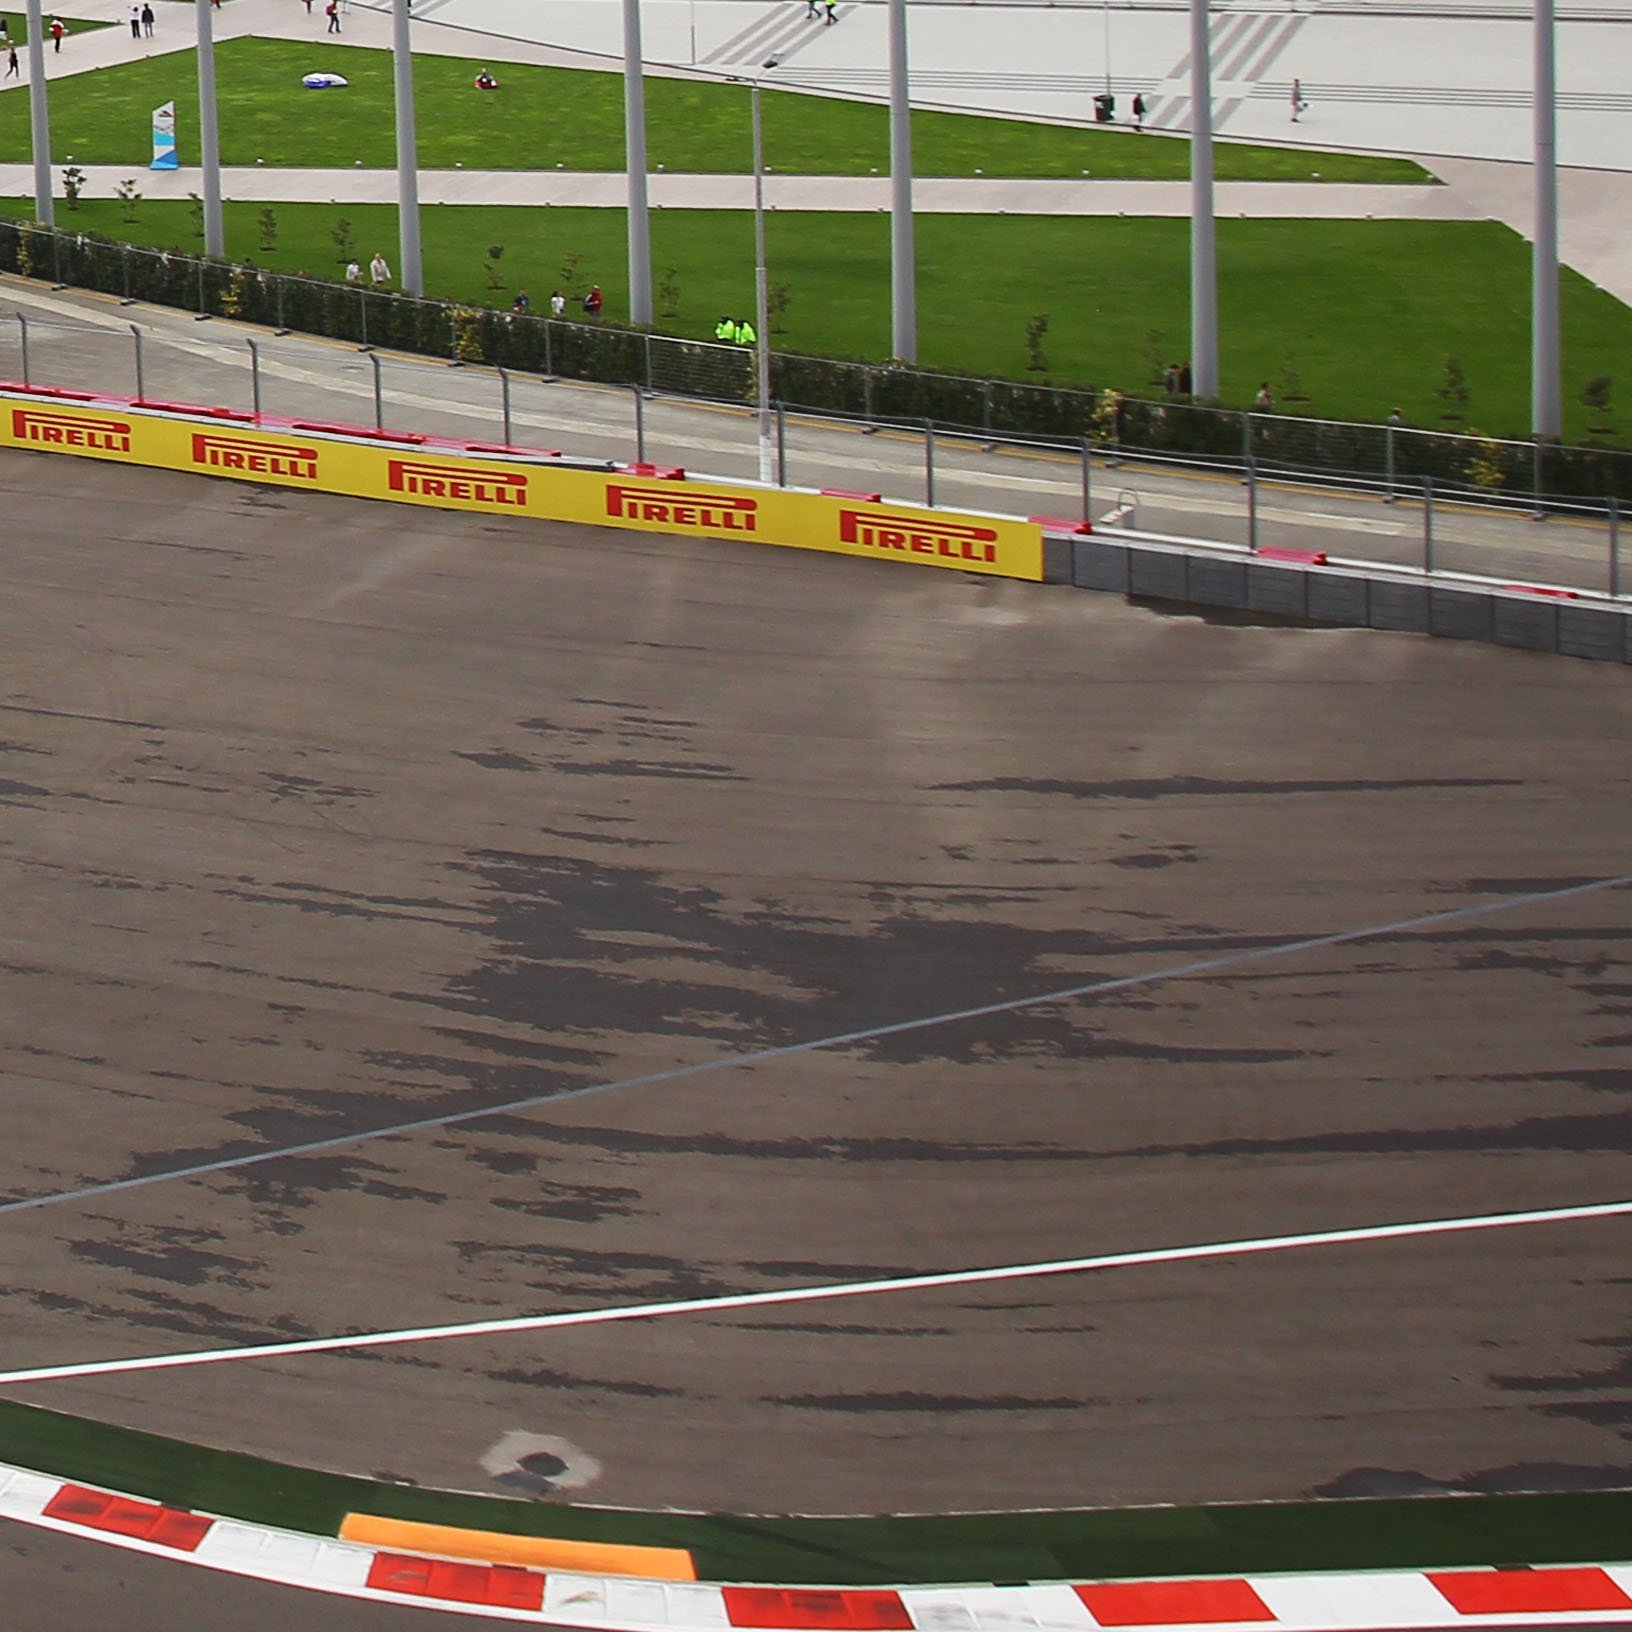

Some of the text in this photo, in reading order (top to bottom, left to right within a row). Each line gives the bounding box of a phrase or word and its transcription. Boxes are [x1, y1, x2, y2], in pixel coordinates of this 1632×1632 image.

[12, 410, 131, 452] PIRELLI
[192, 433, 318, 479] PIRELLI
[388, 460, 528, 505] PIRELLI
[606, 485, 758, 531] PIRELLI
[839, 510, 998, 562] PIRELLI
